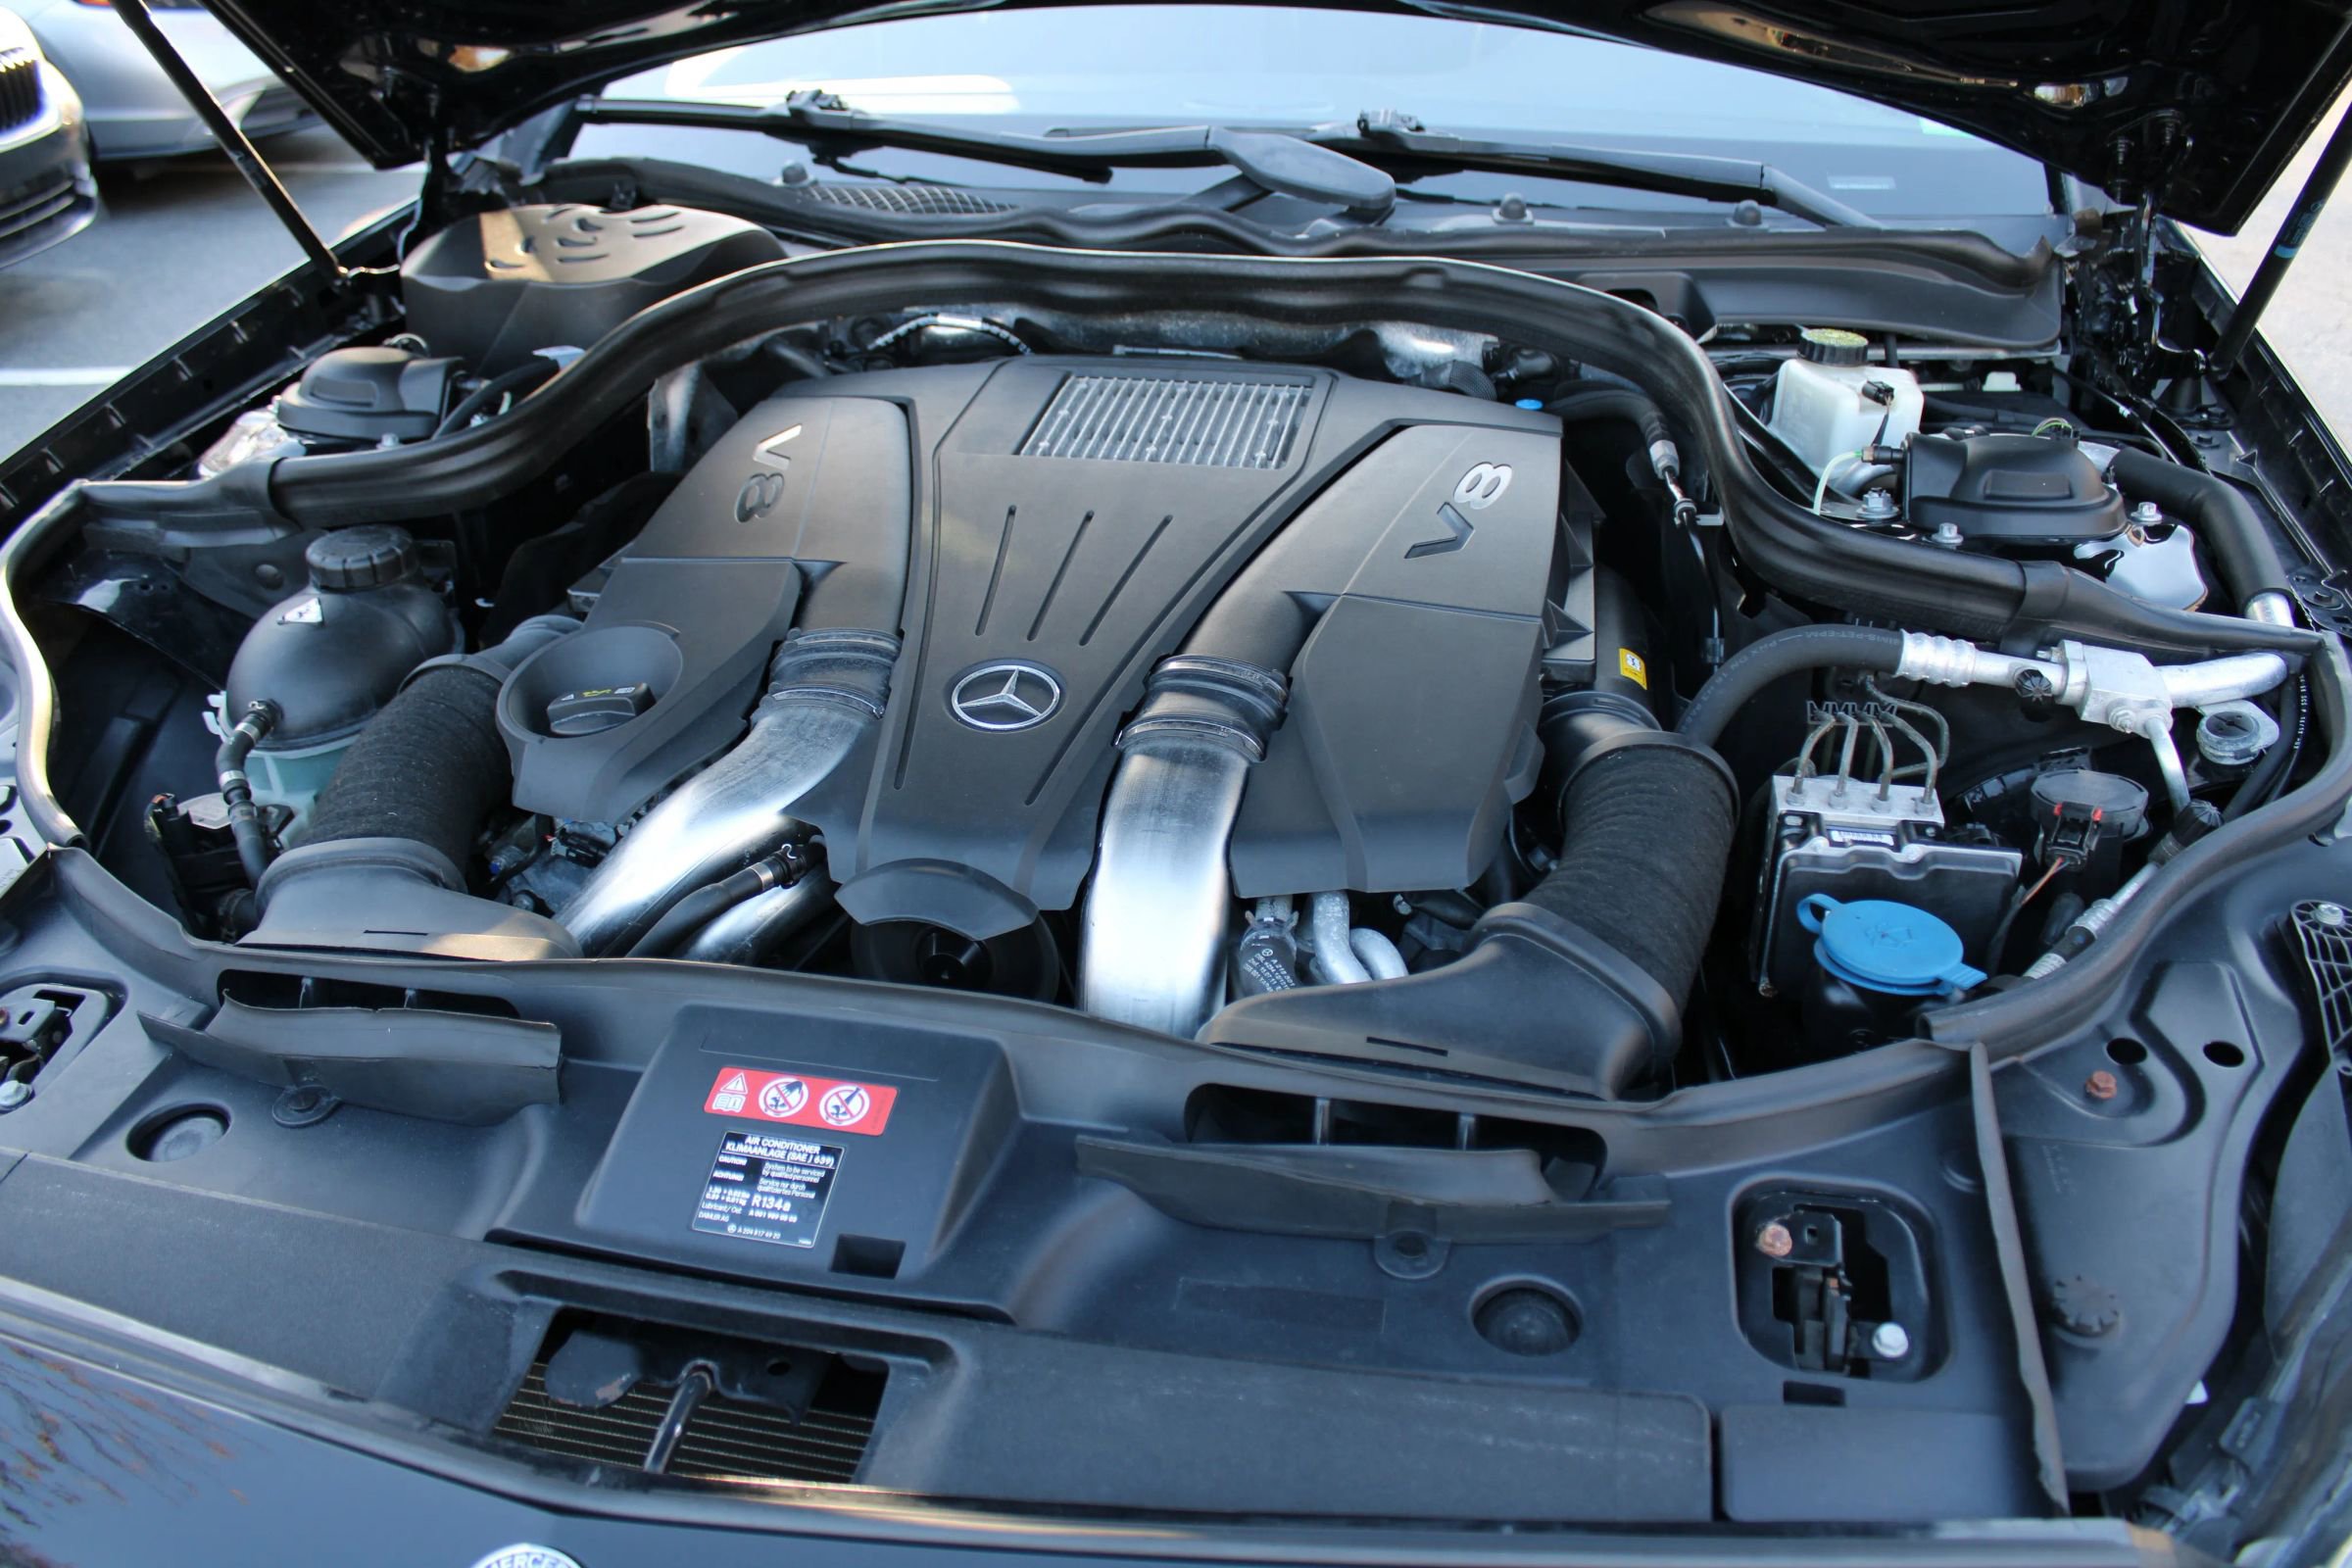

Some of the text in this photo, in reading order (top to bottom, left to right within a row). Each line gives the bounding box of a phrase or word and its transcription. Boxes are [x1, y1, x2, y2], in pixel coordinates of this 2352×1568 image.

[734, 422, 803, 524] V8
[1403, 461, 1513, 560] V8
[725, 1142, 786, 1158] KLIMAANLAGE
[788, 1152, 807, 1163] (SAE
[813, 1155, 835, 1166] 639)
[745, 1136, 820, 1154] AIR CONDITIONER
[752, 1194, 791, 1211] R134a
[486, 1552, 568, 1568] ERCE
